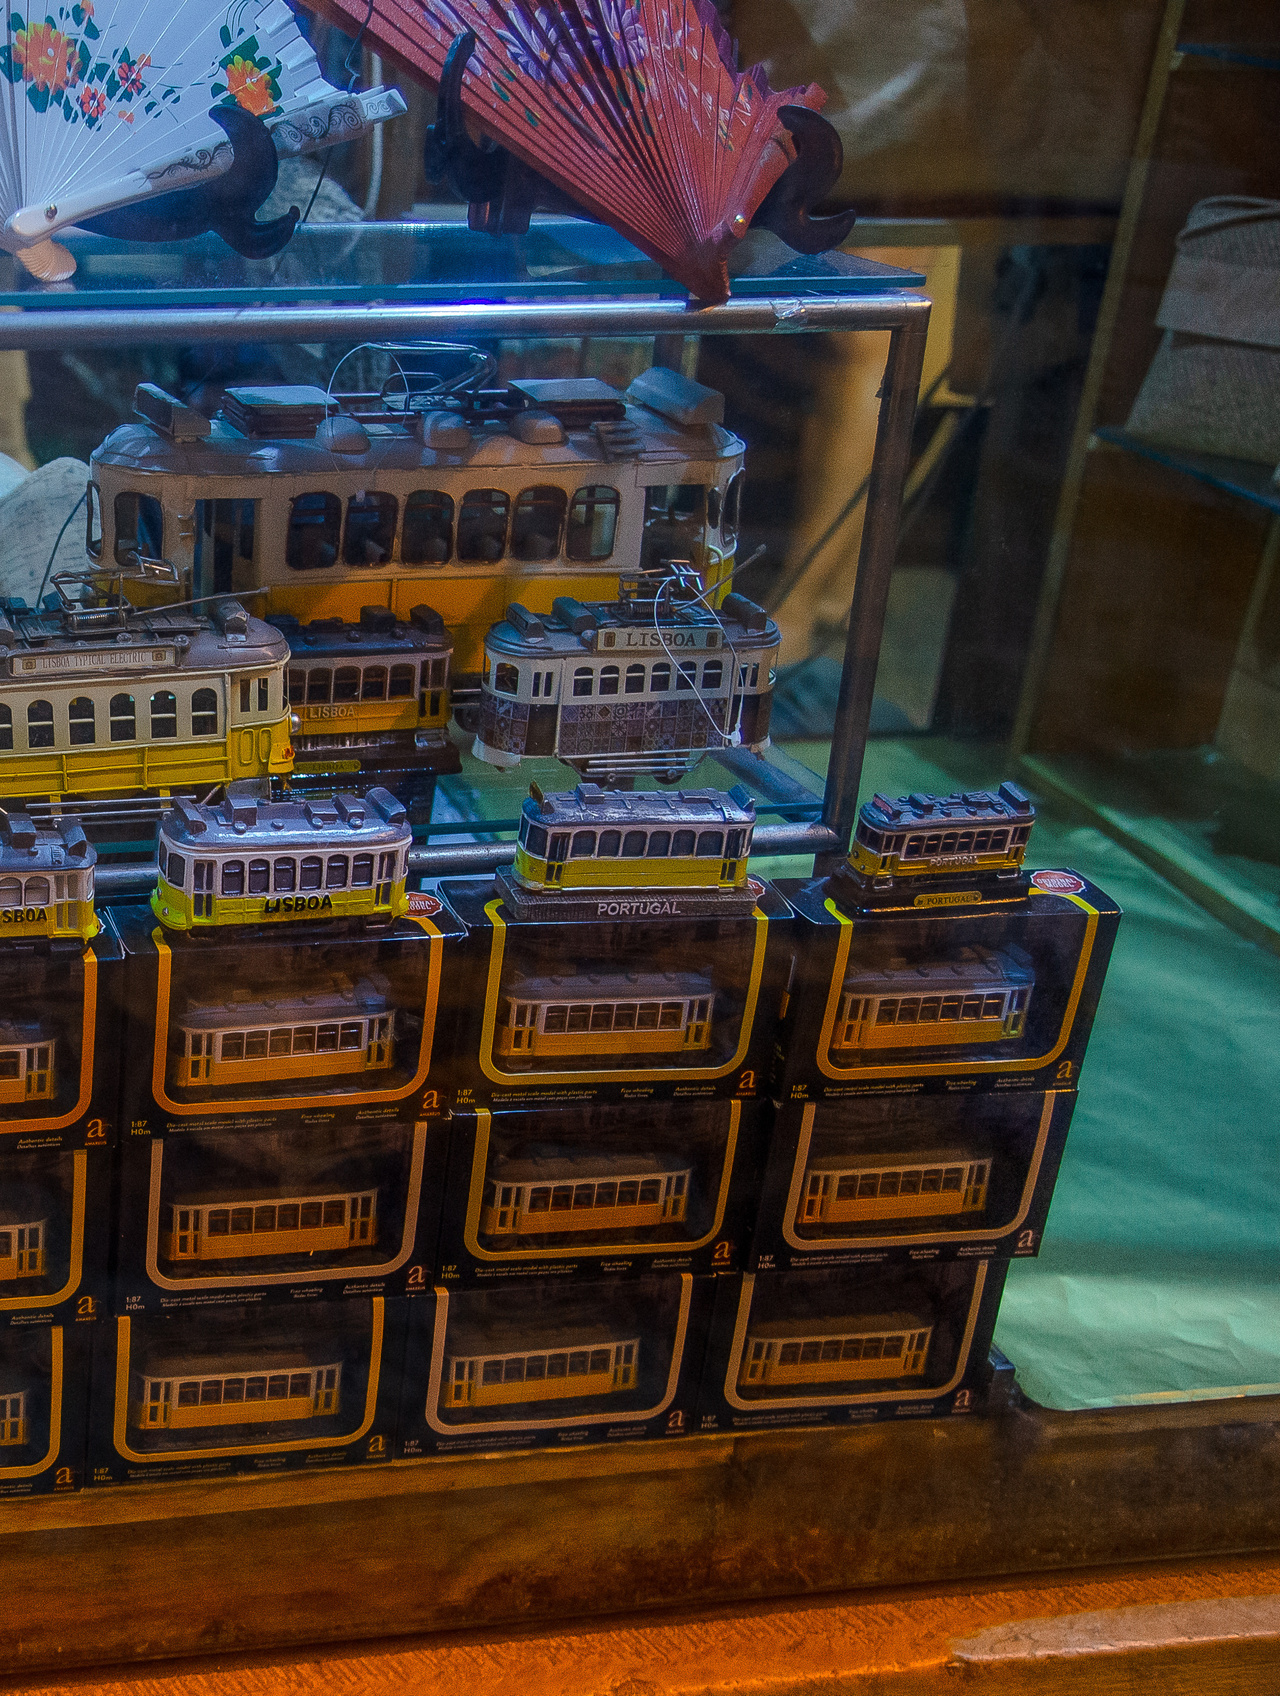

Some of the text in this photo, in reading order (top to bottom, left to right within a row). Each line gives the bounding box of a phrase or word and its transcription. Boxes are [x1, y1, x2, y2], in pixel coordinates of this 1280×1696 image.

[626, 632, 696, 647] LISBOA
[310, 706, 355, 718] LISBOA
[264, 894, 333, 913] LISBOA
[597, 902, 682, 916] PORTUGAL
[927, 896, 970, 906] PORTUGAL
[739, 1070, 756, 1090] a
[423, 1089, 441, 1109] a
[86, 1118, 106, 1138] a
[130, 1120, 148, 1128] 1:87
[1017, 1229, 1034, 1248] a
[714, 1241, 731, 1259] a
[408, 1265, 425, 1284] a
[77, 1295, 96, 1314] a
[368, 1434, 386, 1453] a
[56, 1466, 74, 1484] a
